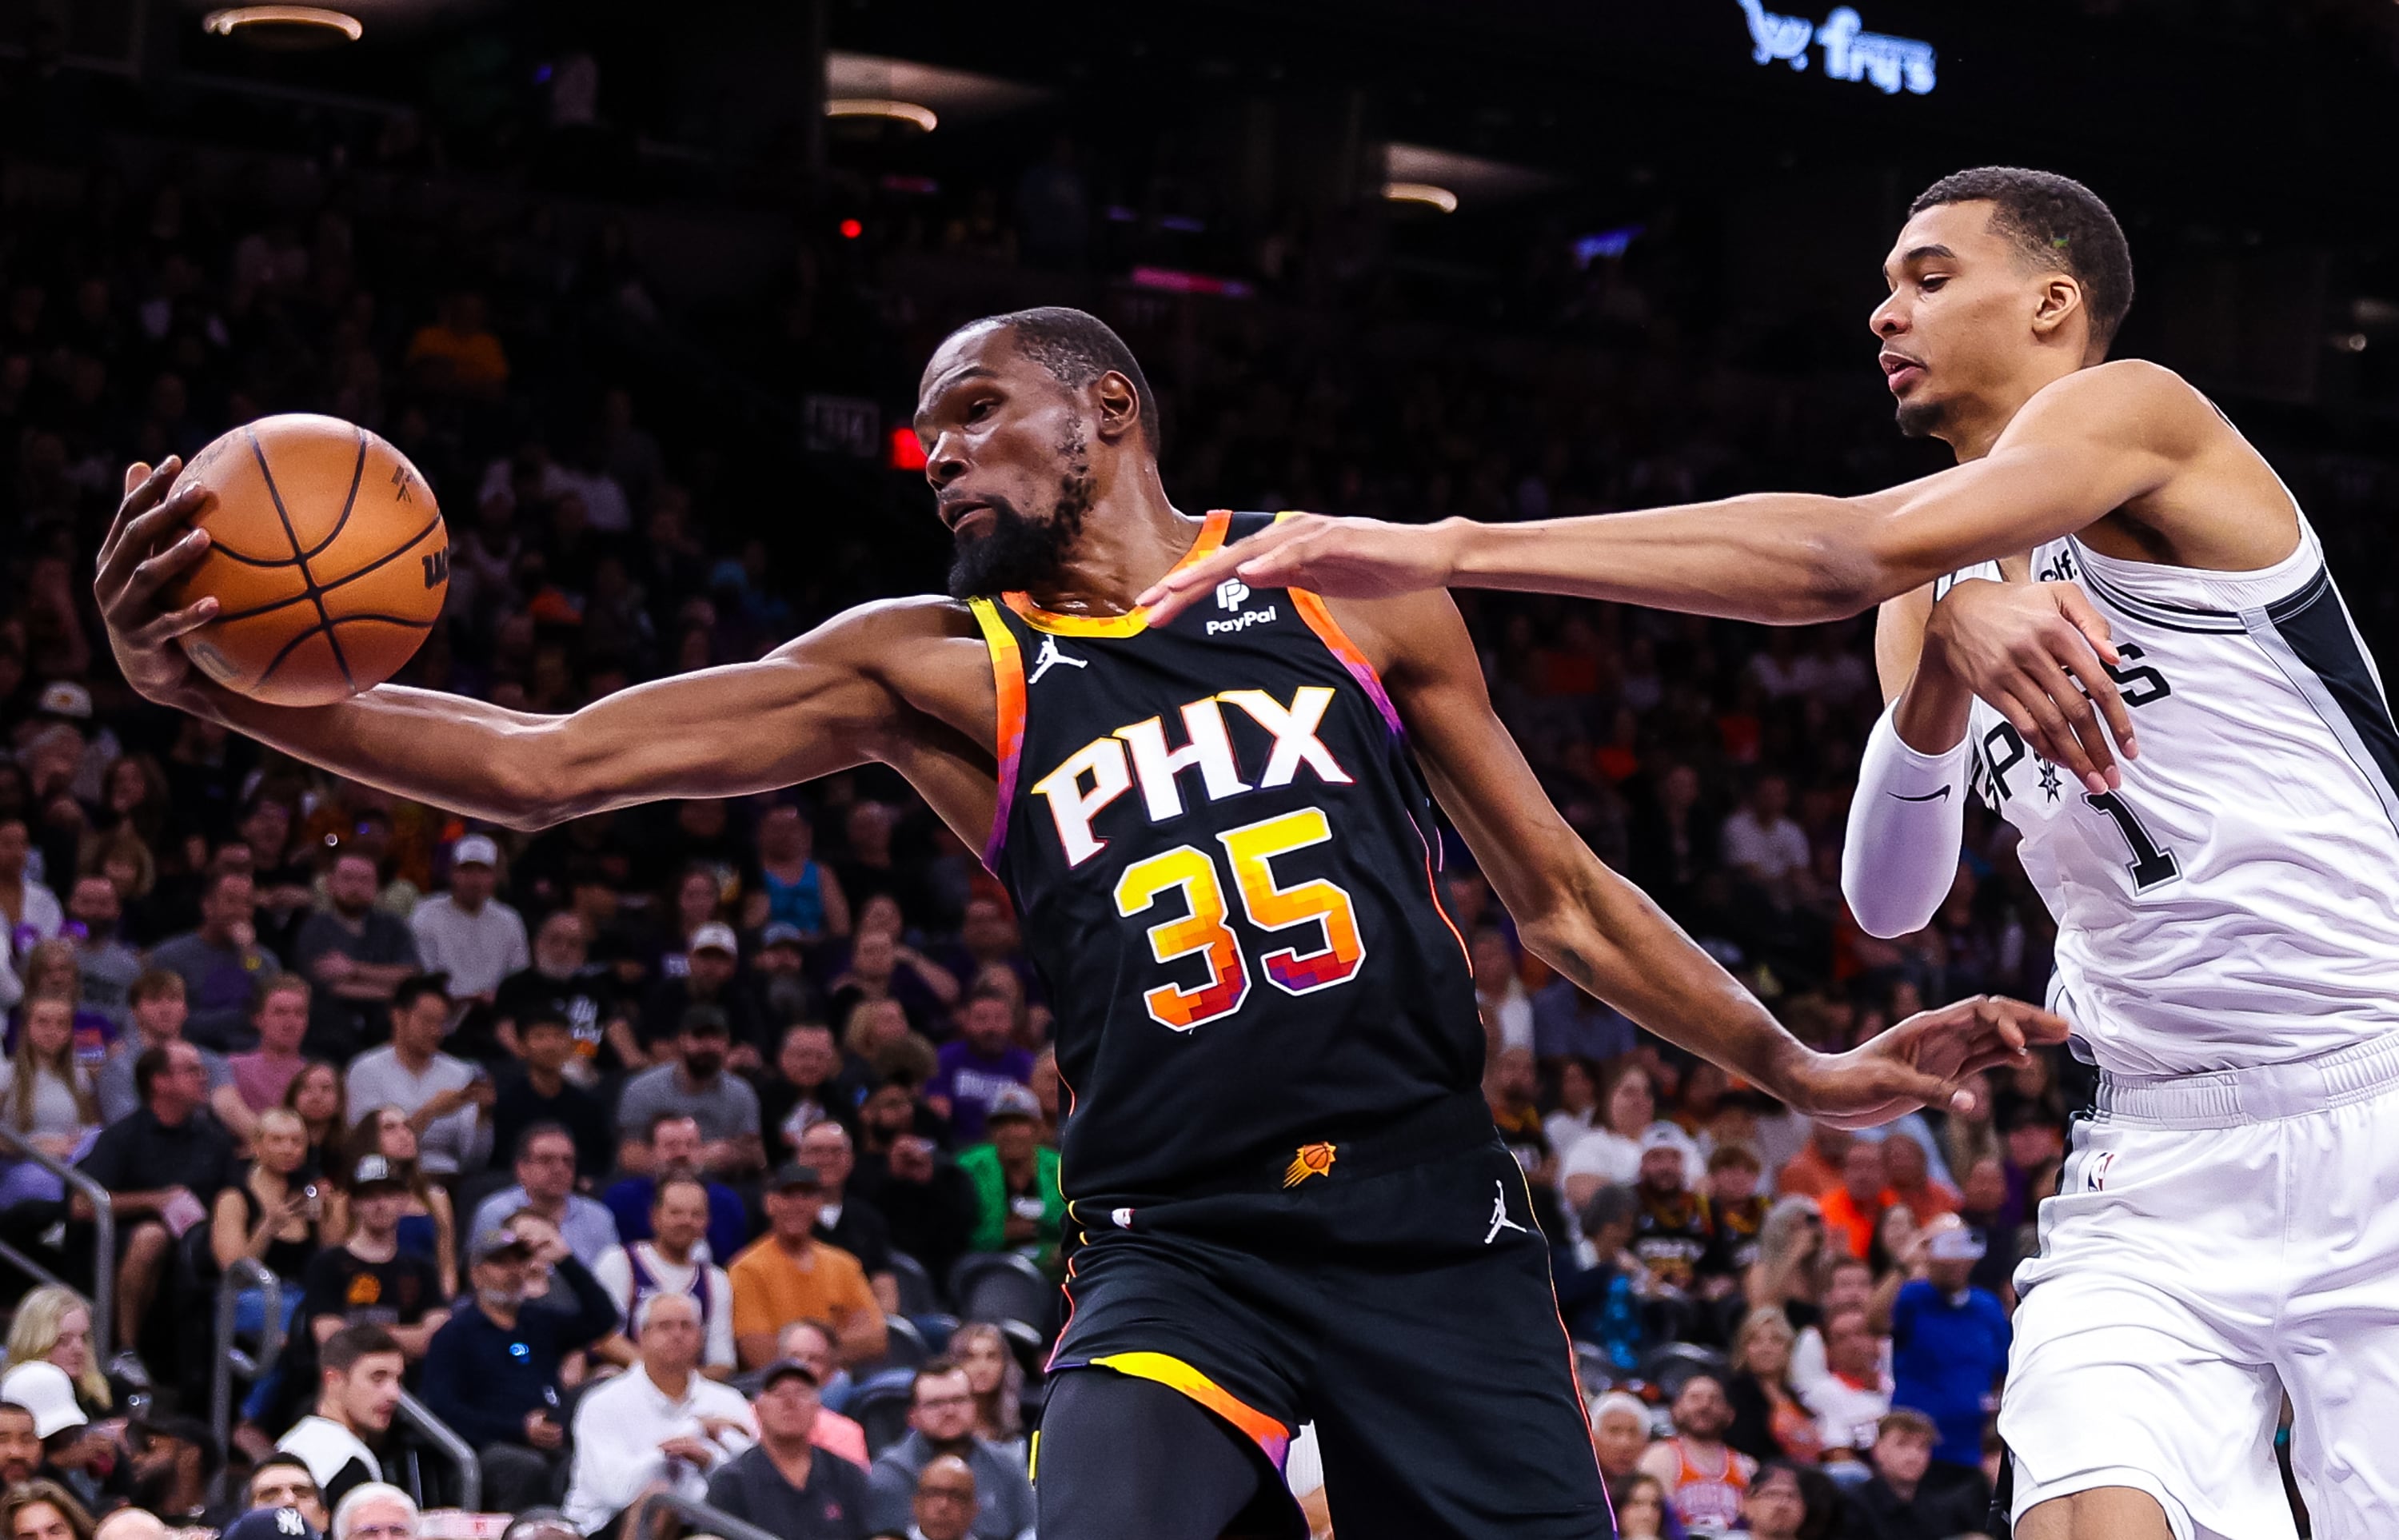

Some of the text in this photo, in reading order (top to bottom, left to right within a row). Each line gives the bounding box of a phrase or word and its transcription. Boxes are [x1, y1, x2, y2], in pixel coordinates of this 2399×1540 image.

[1206, 605, 1276, 635] PayPal
[1032, 686, 1357, 869] PHX
[2080, 787, 2183, 897] 1
[1113, 807, 1366, 1031] 35
